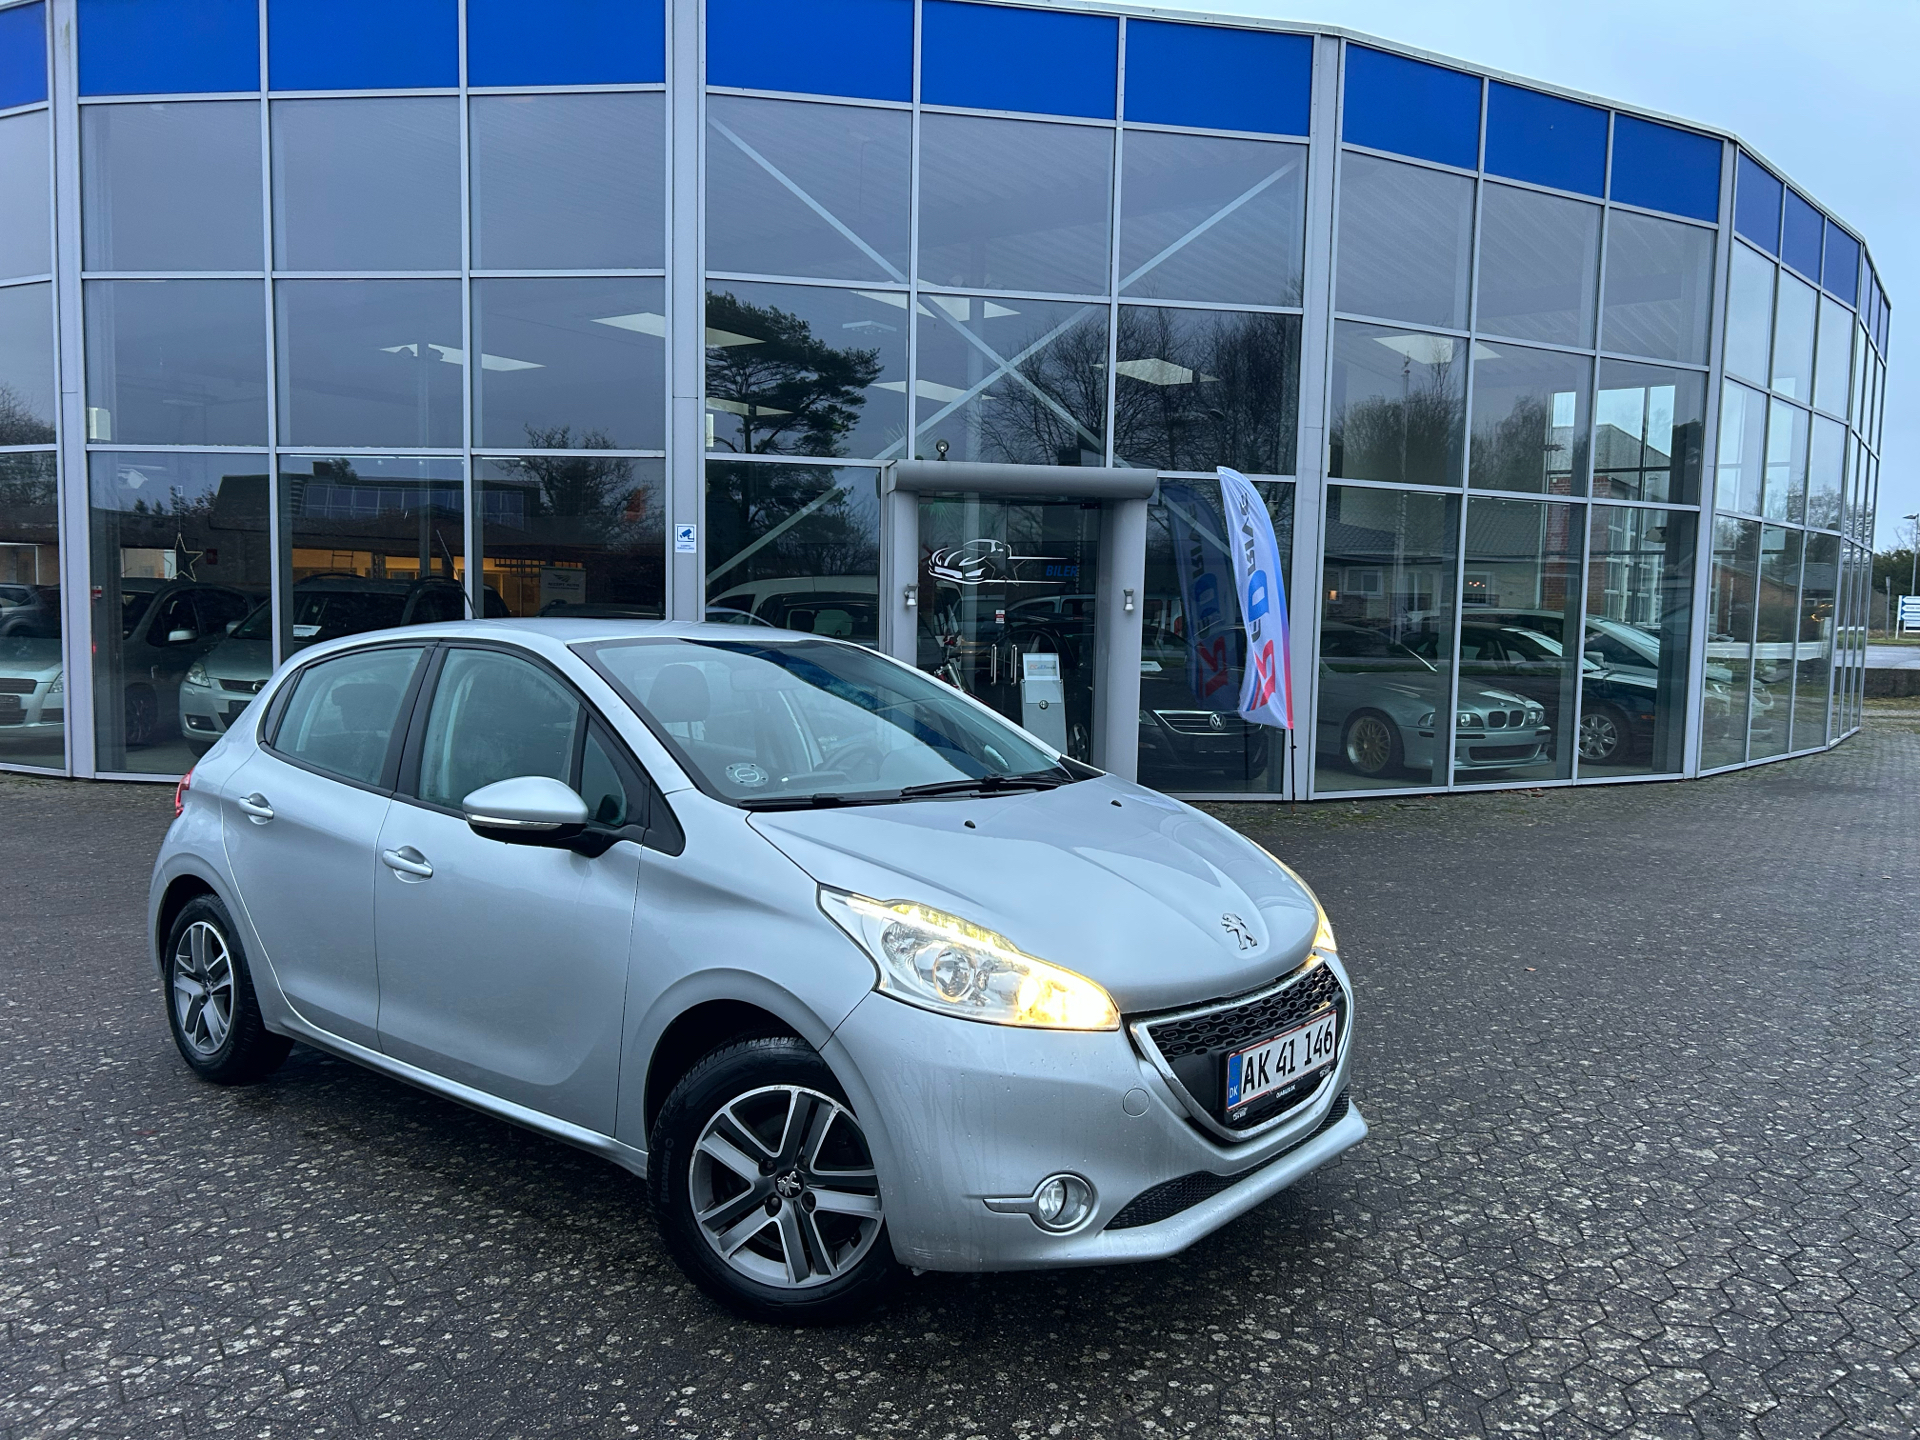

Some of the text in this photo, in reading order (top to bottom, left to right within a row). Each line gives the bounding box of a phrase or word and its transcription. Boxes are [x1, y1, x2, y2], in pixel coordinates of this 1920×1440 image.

[1045, 565, 1078, 577] BILER
[1242, 1020, 1333, 1094] AK 41 146
[1229, 1085, 1238, 1099] DK
